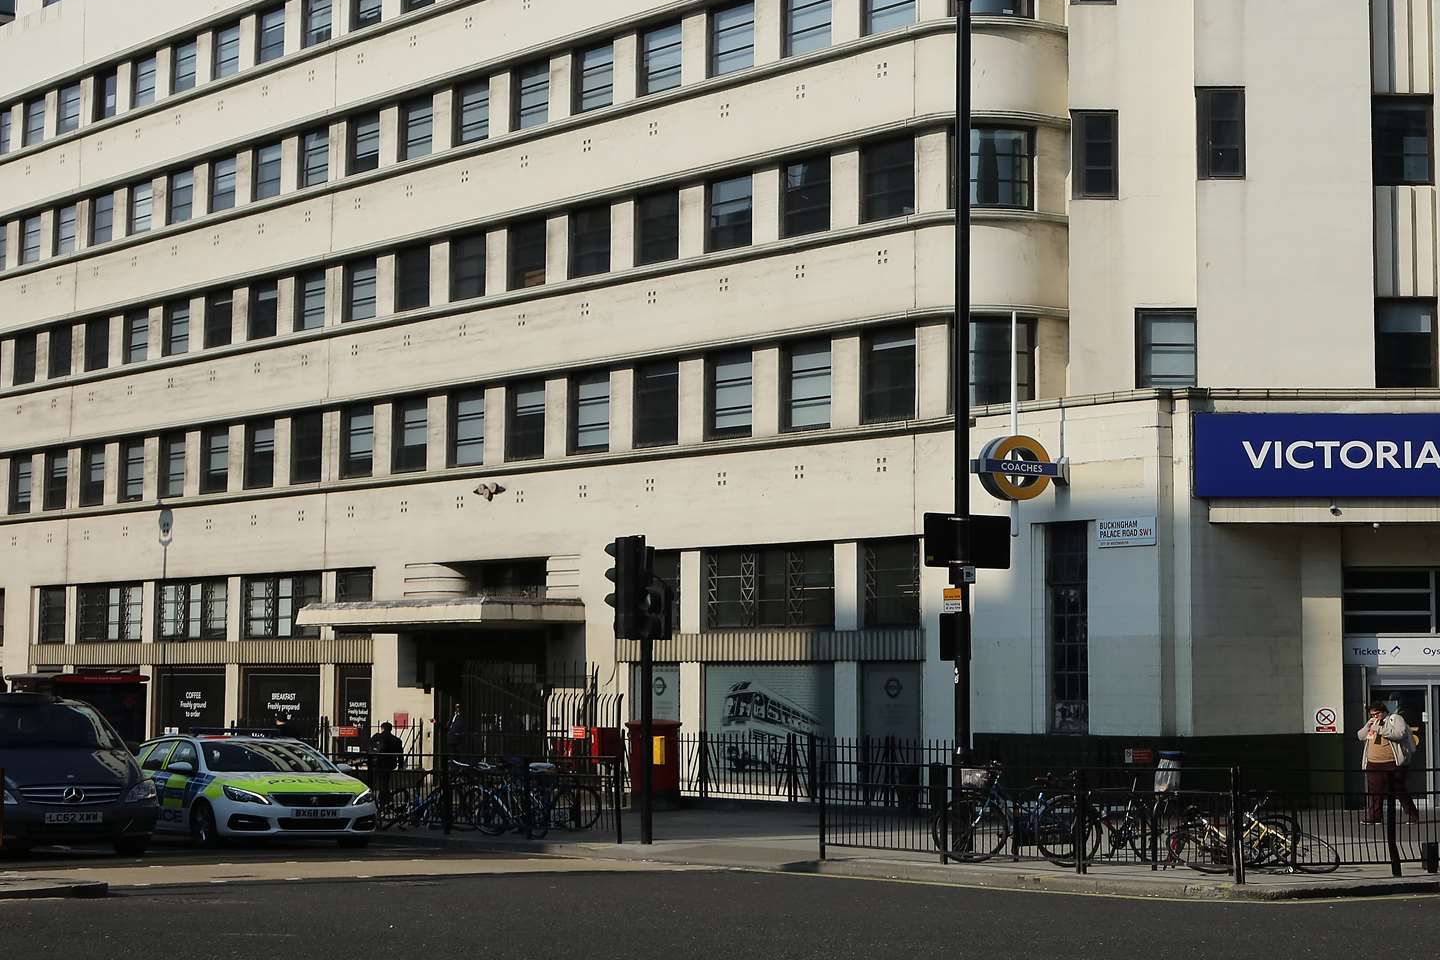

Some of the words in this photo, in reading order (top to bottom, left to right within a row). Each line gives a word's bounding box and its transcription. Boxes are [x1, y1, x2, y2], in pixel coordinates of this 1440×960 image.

[1001, 462, 1043, 473] COACHES
[1099, 520, 1138, 530] BUCKINGHAM
[1099, 529, 1120, 538] PALACE
[1122, 529, 1138, 537] ROAD
[1139, 528, 1152, 537] SW1
[1353, 647, 1386, 656] Tickets
[185, 691, 202, 700] COFFEE
[272, 692, 296, 701] BREAKFAST
[180, 700, 194, 710] Freshly
[193, 700, 207, 710] ground
[267, 702, 282, 712] Freshly
[281, 702, 301, 713] prepared
[267, 776, 343, 786] POLICE
